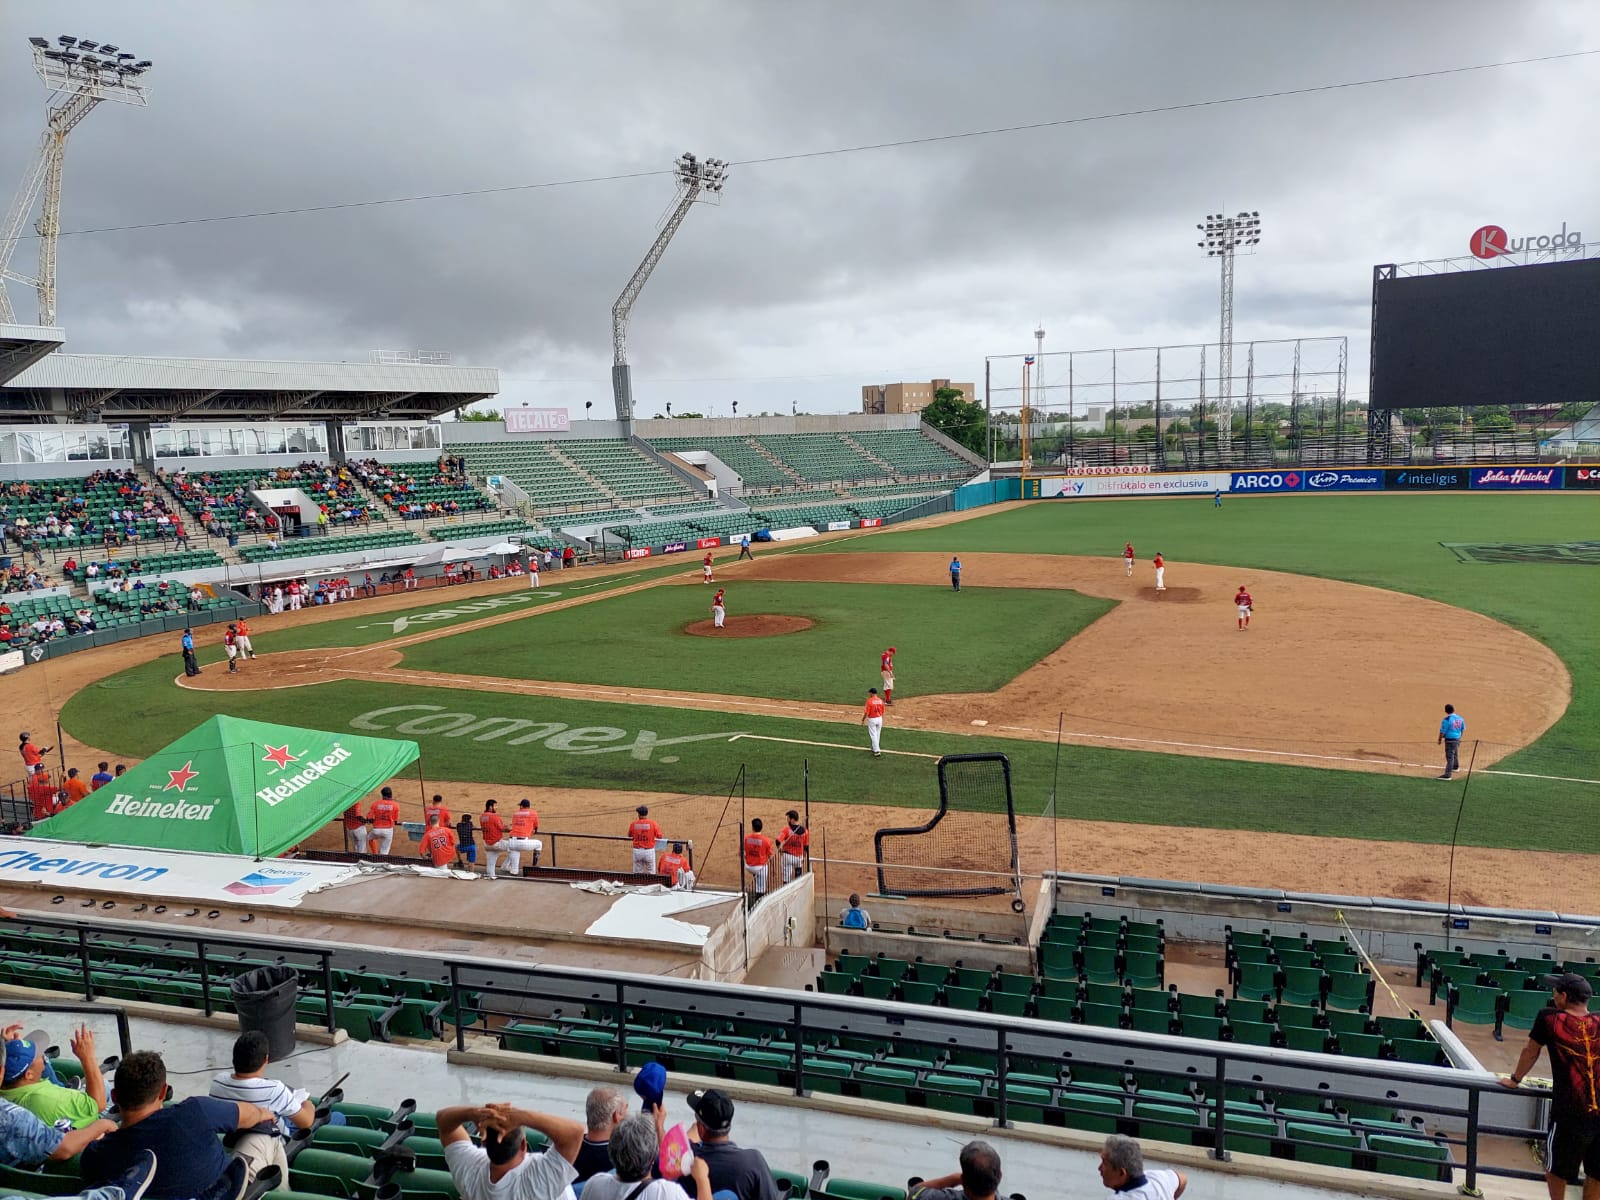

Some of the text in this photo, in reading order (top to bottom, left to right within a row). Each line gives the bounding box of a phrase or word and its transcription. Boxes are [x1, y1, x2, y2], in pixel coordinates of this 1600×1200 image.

[1479, 222, 1581, 255] Kuroda
[1235, 475, 1283, 488] ARCO
[1340, 475, 1377, 484] Premier
[1408, 472, 1457, 486] inteligis
[1478, 469, 1553, 484] Salsa Huichol
[1149, 481, 1161, 490] en
[1163, 480, 1209, 489] exclusiva
[256, 745, 352, 807] Heineken
[105, 793, 215, 821] Heineken
[258, 867, 312, 877] Chevron
